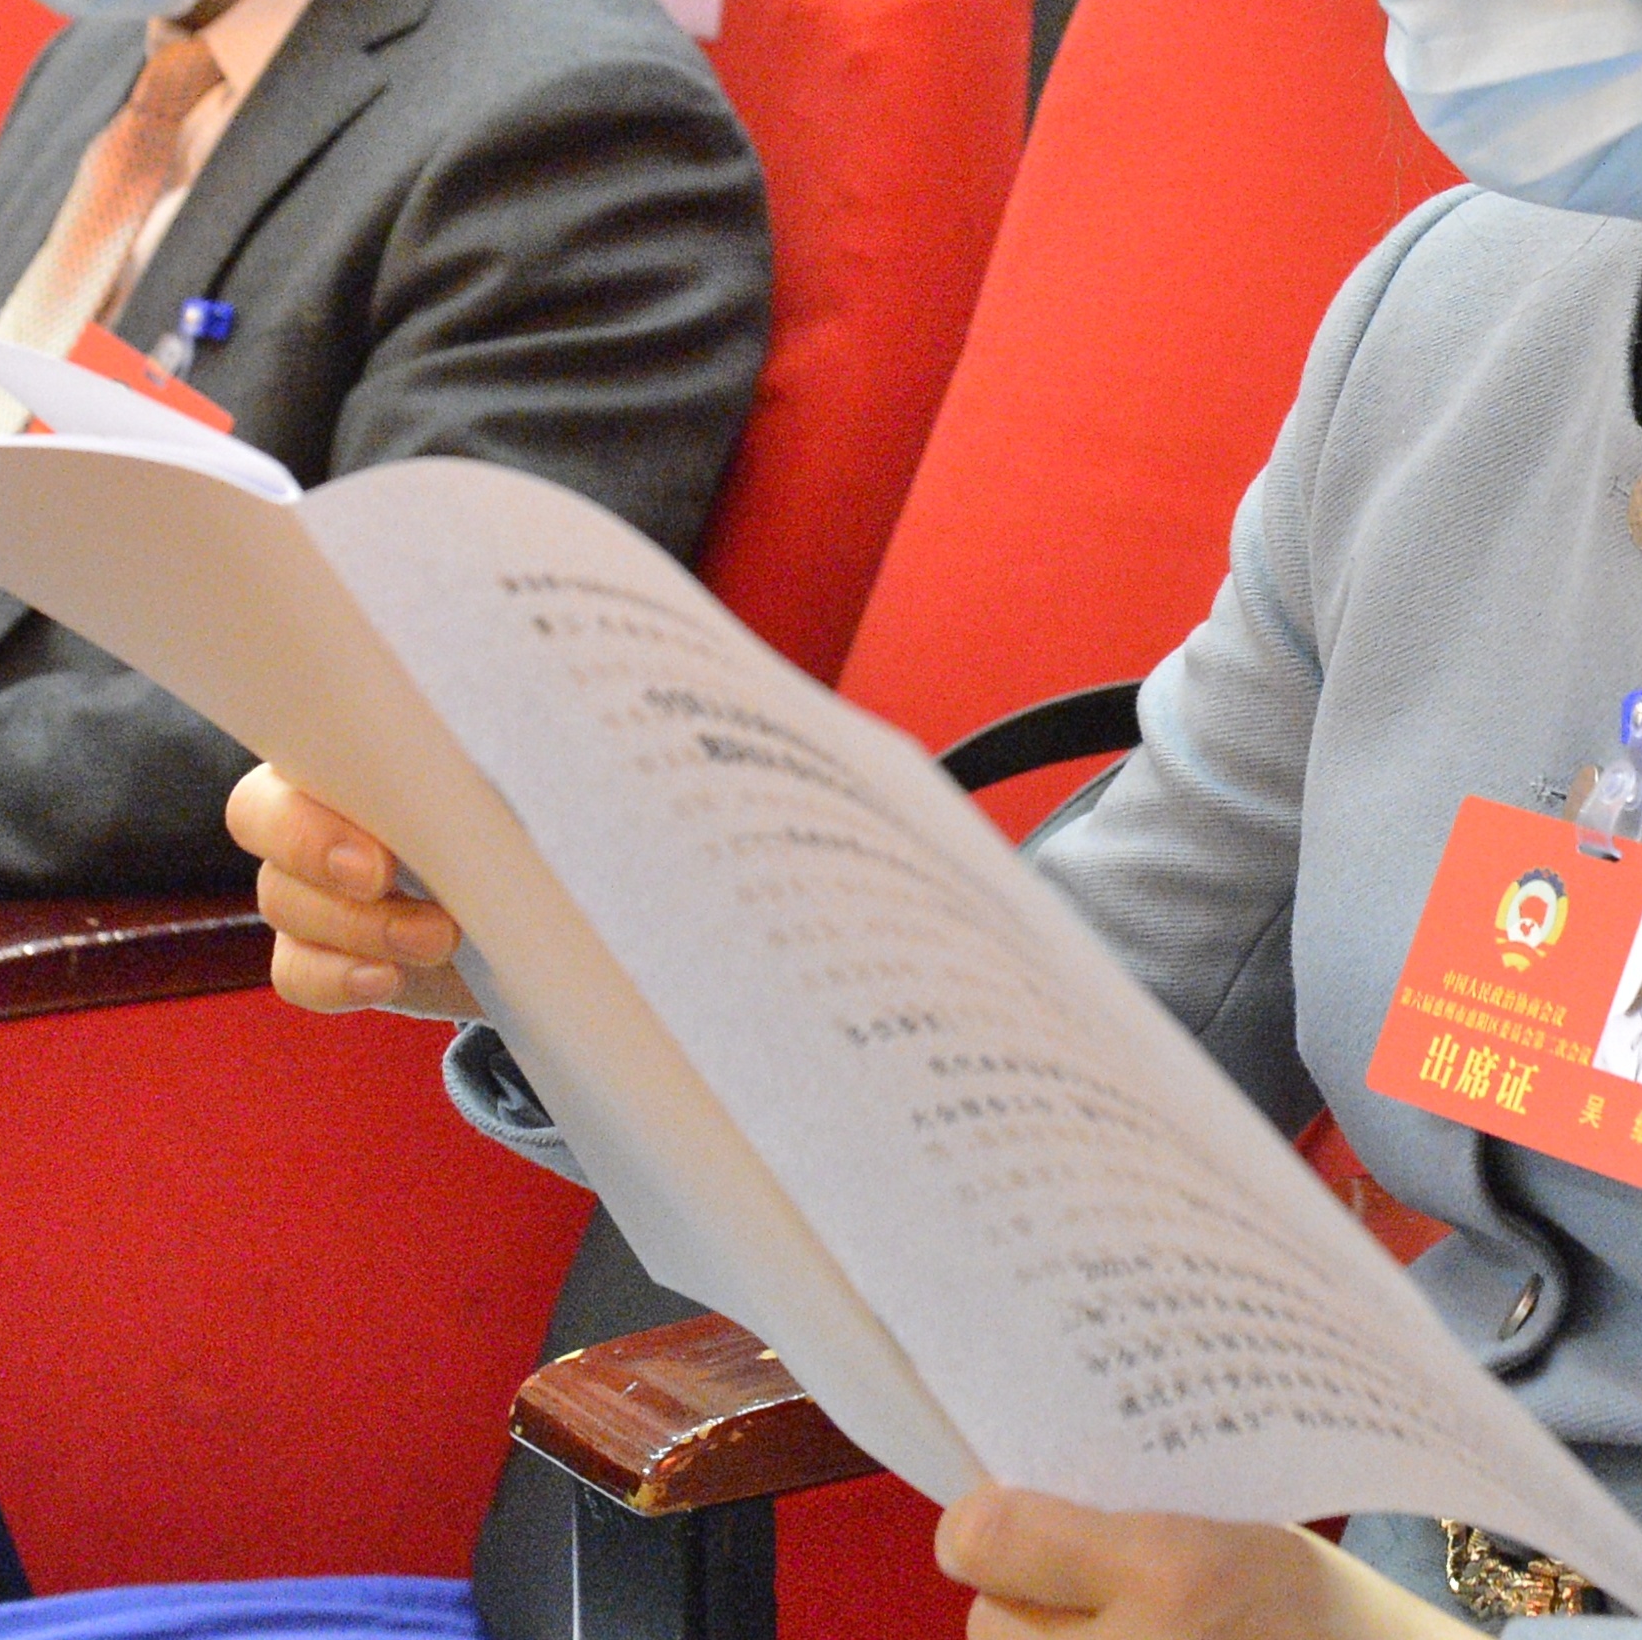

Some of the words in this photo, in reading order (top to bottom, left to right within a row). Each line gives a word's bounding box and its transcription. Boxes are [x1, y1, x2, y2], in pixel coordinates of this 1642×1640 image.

[1442, 970, 1568, 1028] 中国人民政治协商会议
[1419, 1032, 1540, 1115] 出席证
